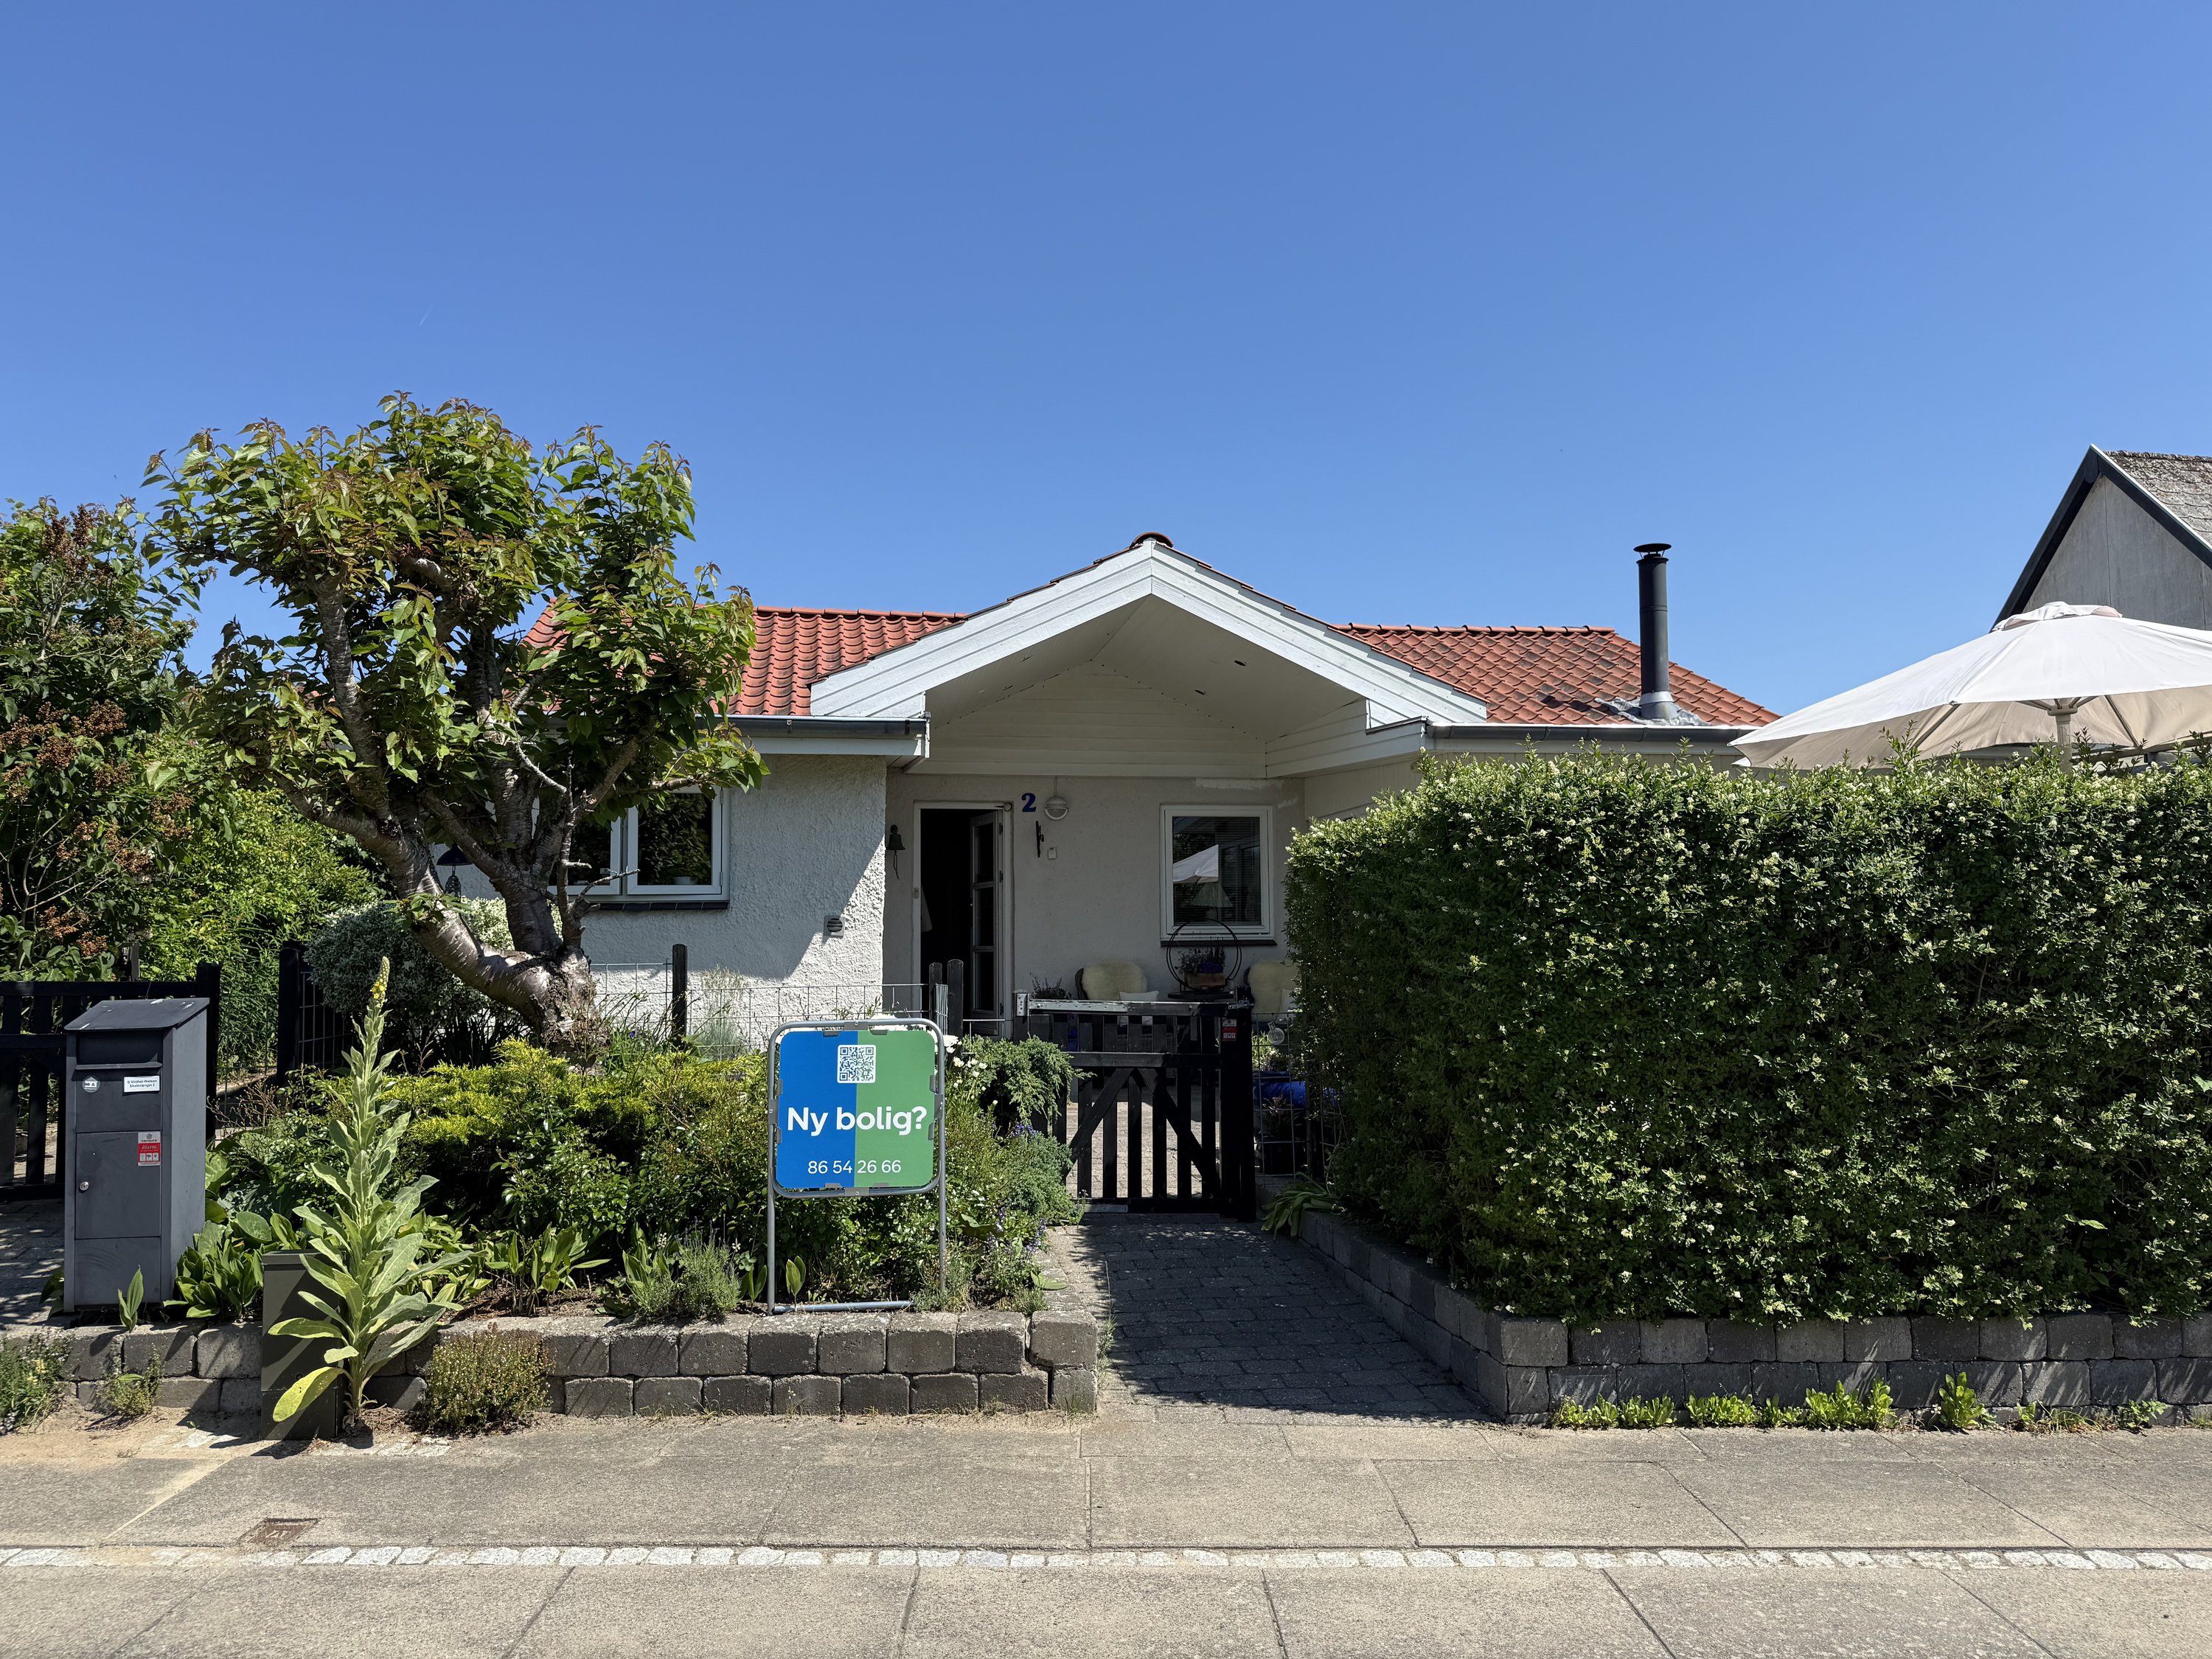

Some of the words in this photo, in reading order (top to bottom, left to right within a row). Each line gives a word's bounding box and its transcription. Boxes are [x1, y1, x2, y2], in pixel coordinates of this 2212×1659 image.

[1021, 793, 1037, 813] 2
[787, 1107, 829, 1137] Ny
[836, 1106, 928, 1136] bolig?
[807, 1161, 828, 1174] 86
[832, 1160, 853, 1174] 54
[857, 1160, 877, 1174] 26
[881, 1159, 902, 1173] 66
